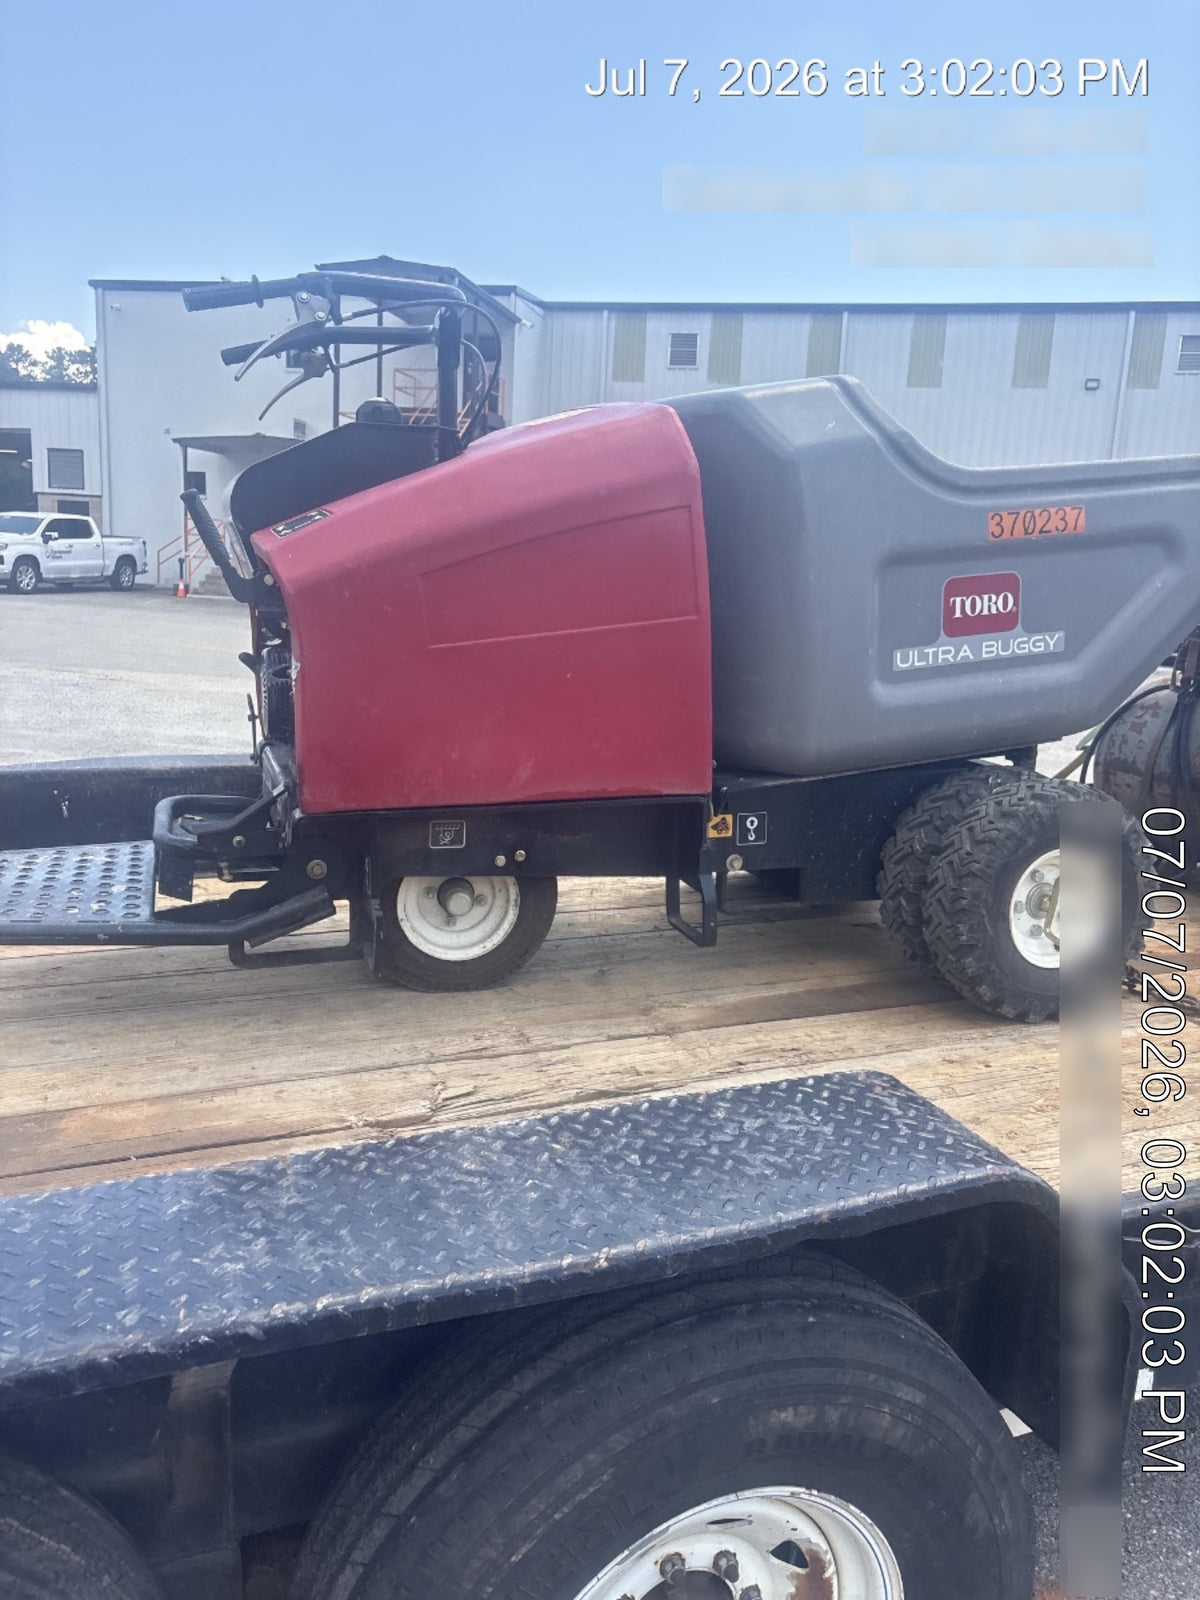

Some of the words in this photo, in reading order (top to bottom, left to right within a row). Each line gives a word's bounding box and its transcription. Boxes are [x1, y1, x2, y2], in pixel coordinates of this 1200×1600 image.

[990, 506, 1083, 539] 370237
[949, 591, 1014, 619] TORO
[896, 644, 974, 668] ULTRA
[981, 633, 1060, 658] BUGGY
